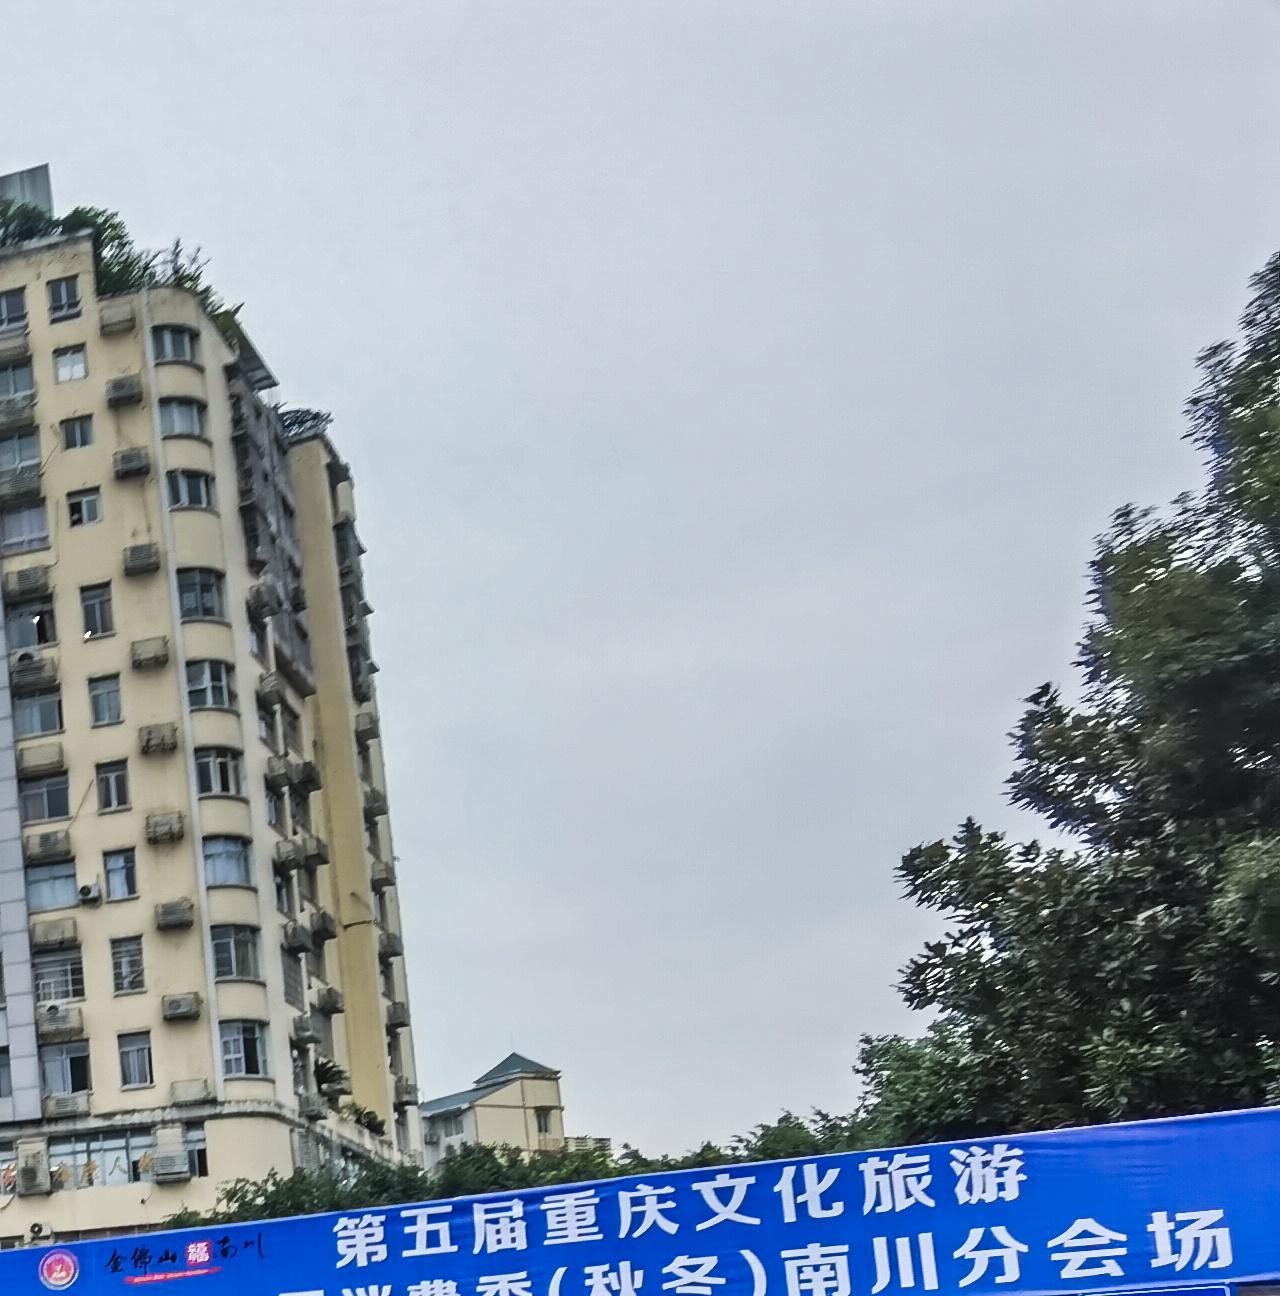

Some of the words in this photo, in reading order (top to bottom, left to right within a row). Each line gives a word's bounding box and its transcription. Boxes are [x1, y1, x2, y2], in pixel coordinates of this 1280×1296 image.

[333, 1143, 1028, 1270] 第五届重庆文化旅游
